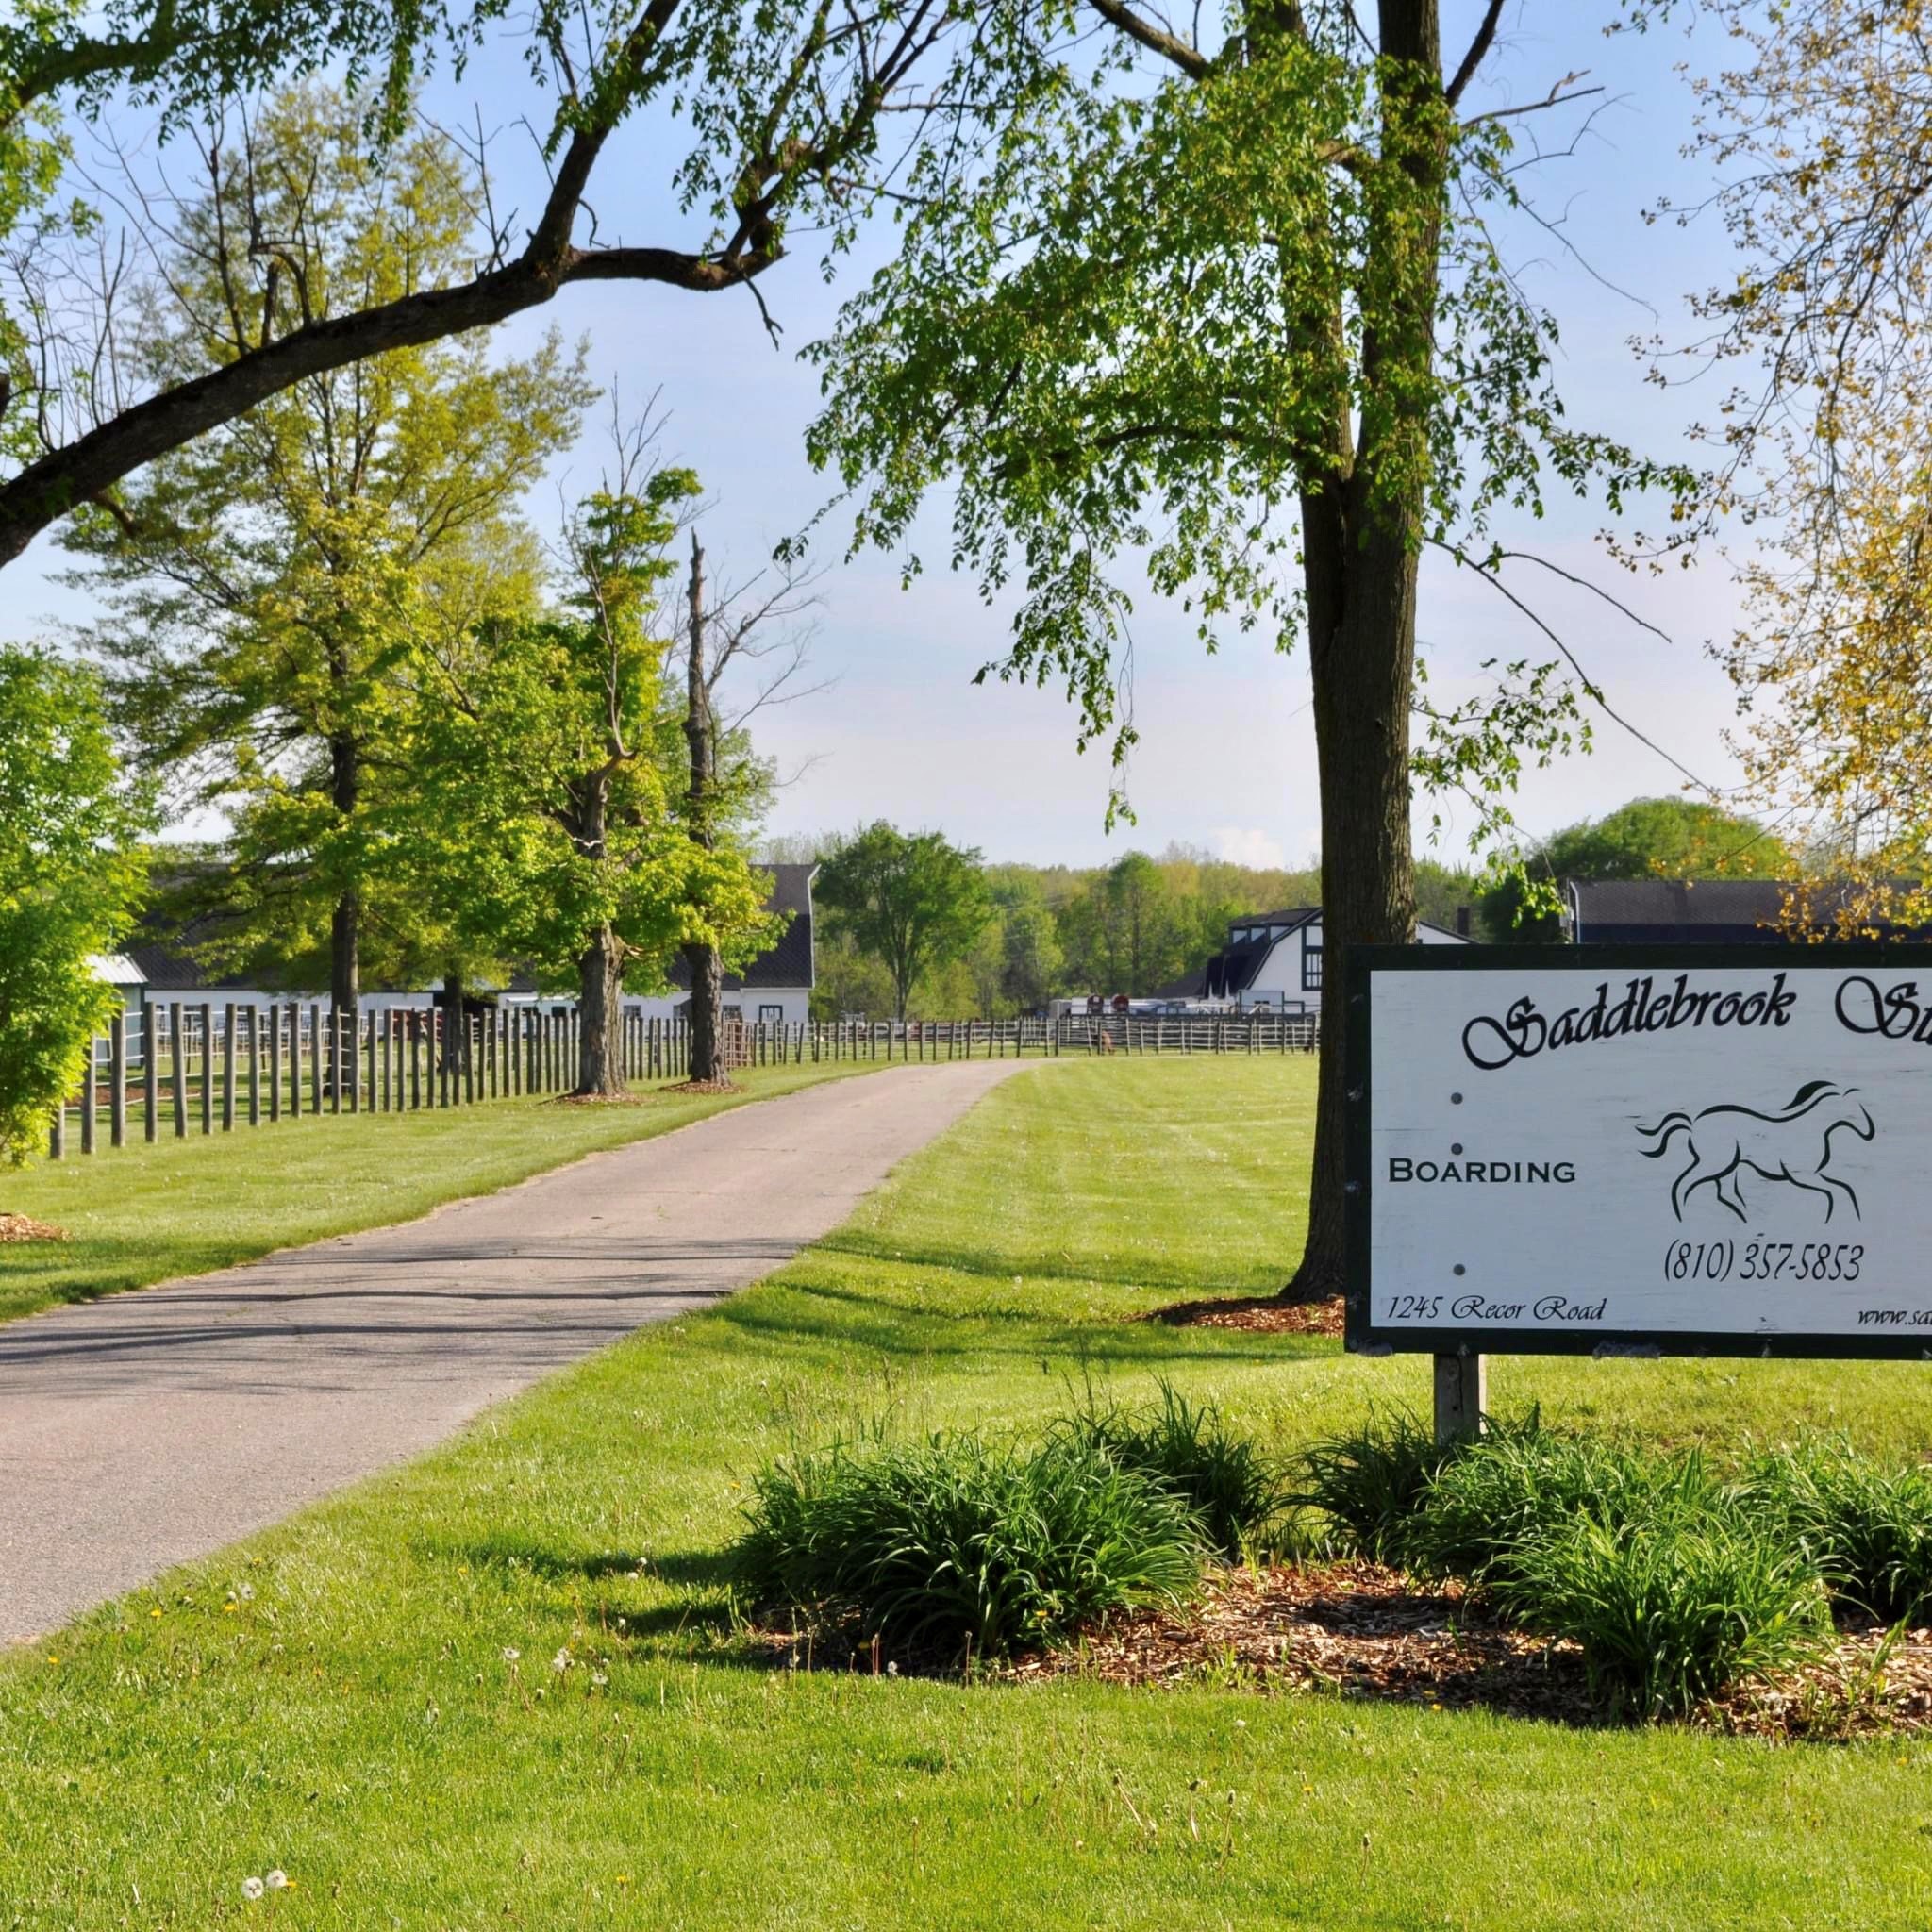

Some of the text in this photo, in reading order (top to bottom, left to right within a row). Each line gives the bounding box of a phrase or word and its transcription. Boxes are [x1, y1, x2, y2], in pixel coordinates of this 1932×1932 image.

[1462, 972, 1797, 1070] Saddlebrook
[1389, 1158, 1575, 1183] BOARDING
[1664, 1239, 1864, 1282] (810) 357-5853
[1388, 1295, 1607, 1321] 1245 Recor Road
[1857, 1310, 1932, 1325] www.sa
